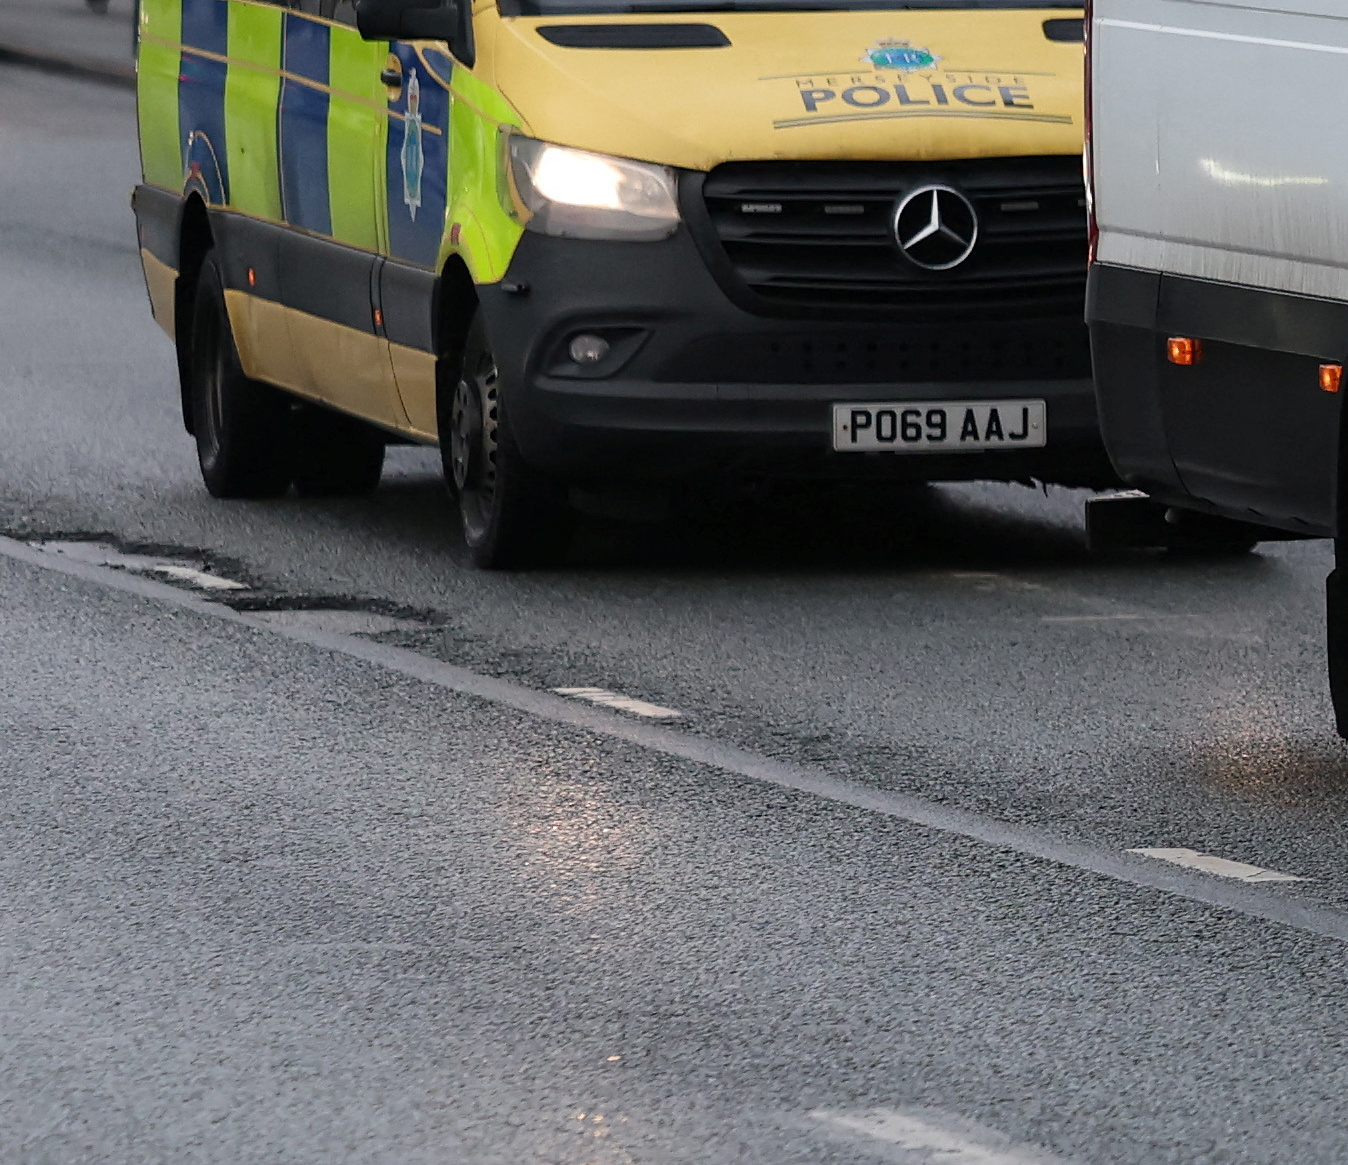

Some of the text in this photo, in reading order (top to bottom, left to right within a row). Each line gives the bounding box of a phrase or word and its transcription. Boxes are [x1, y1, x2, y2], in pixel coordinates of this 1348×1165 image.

[796, 73, 1025, 88] MERSEYSIDE
[800, 83, 1034, 113] POLICE
[850, 407, 1030, 443] PO69 AAJ
